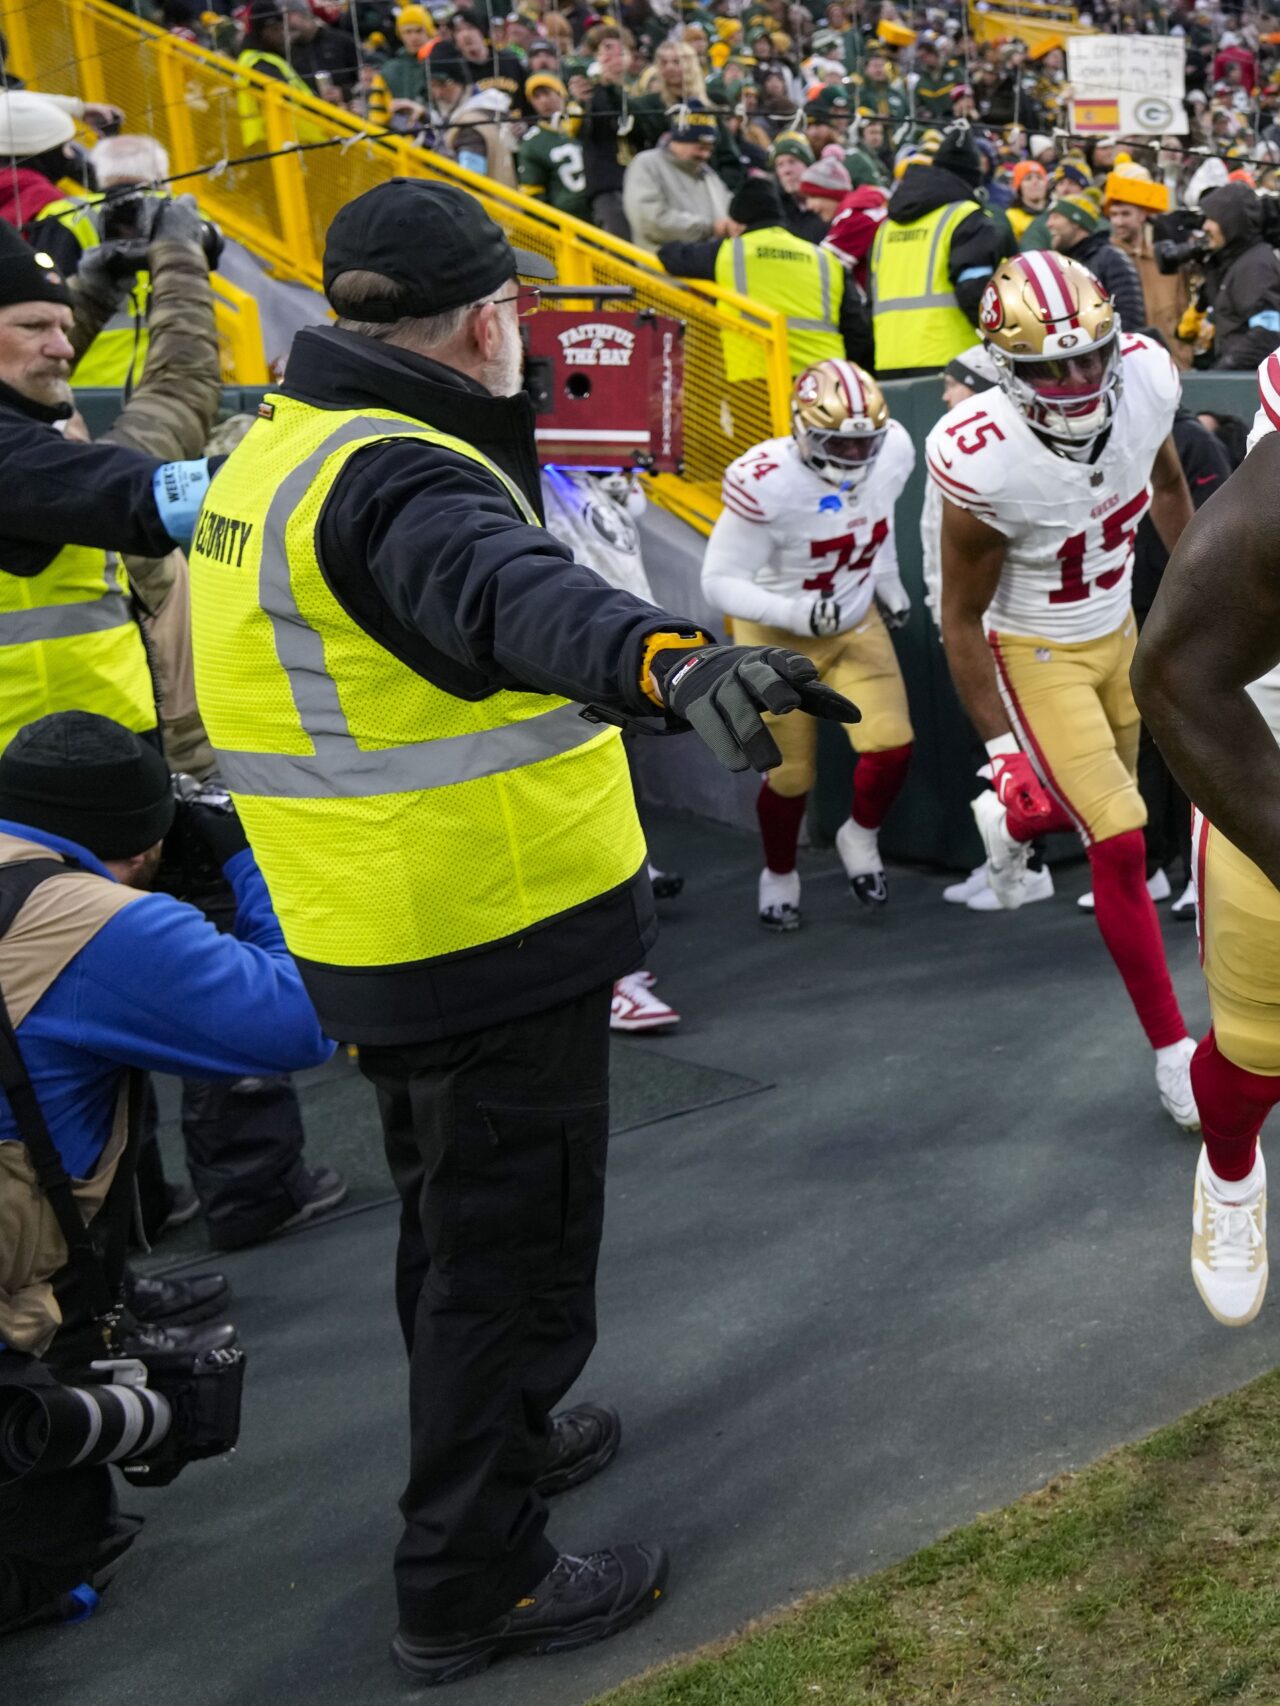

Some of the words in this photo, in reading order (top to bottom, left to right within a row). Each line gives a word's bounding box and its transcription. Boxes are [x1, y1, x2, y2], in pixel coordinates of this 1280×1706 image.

[887, 228, 929, 244] SECURITY
[755, 246, 813, 263] SECURITY
[557, 323, 636, 349] FAITHFUL
[563, 348, 598, 366] THE
[598, 348, 634, 366] BAY
[945, 411, 1006, 455] 15
[739, 452, 780, 481] 74
[802, 515, 889, 592] 74
[1048, 486, 1150, 604] 15
